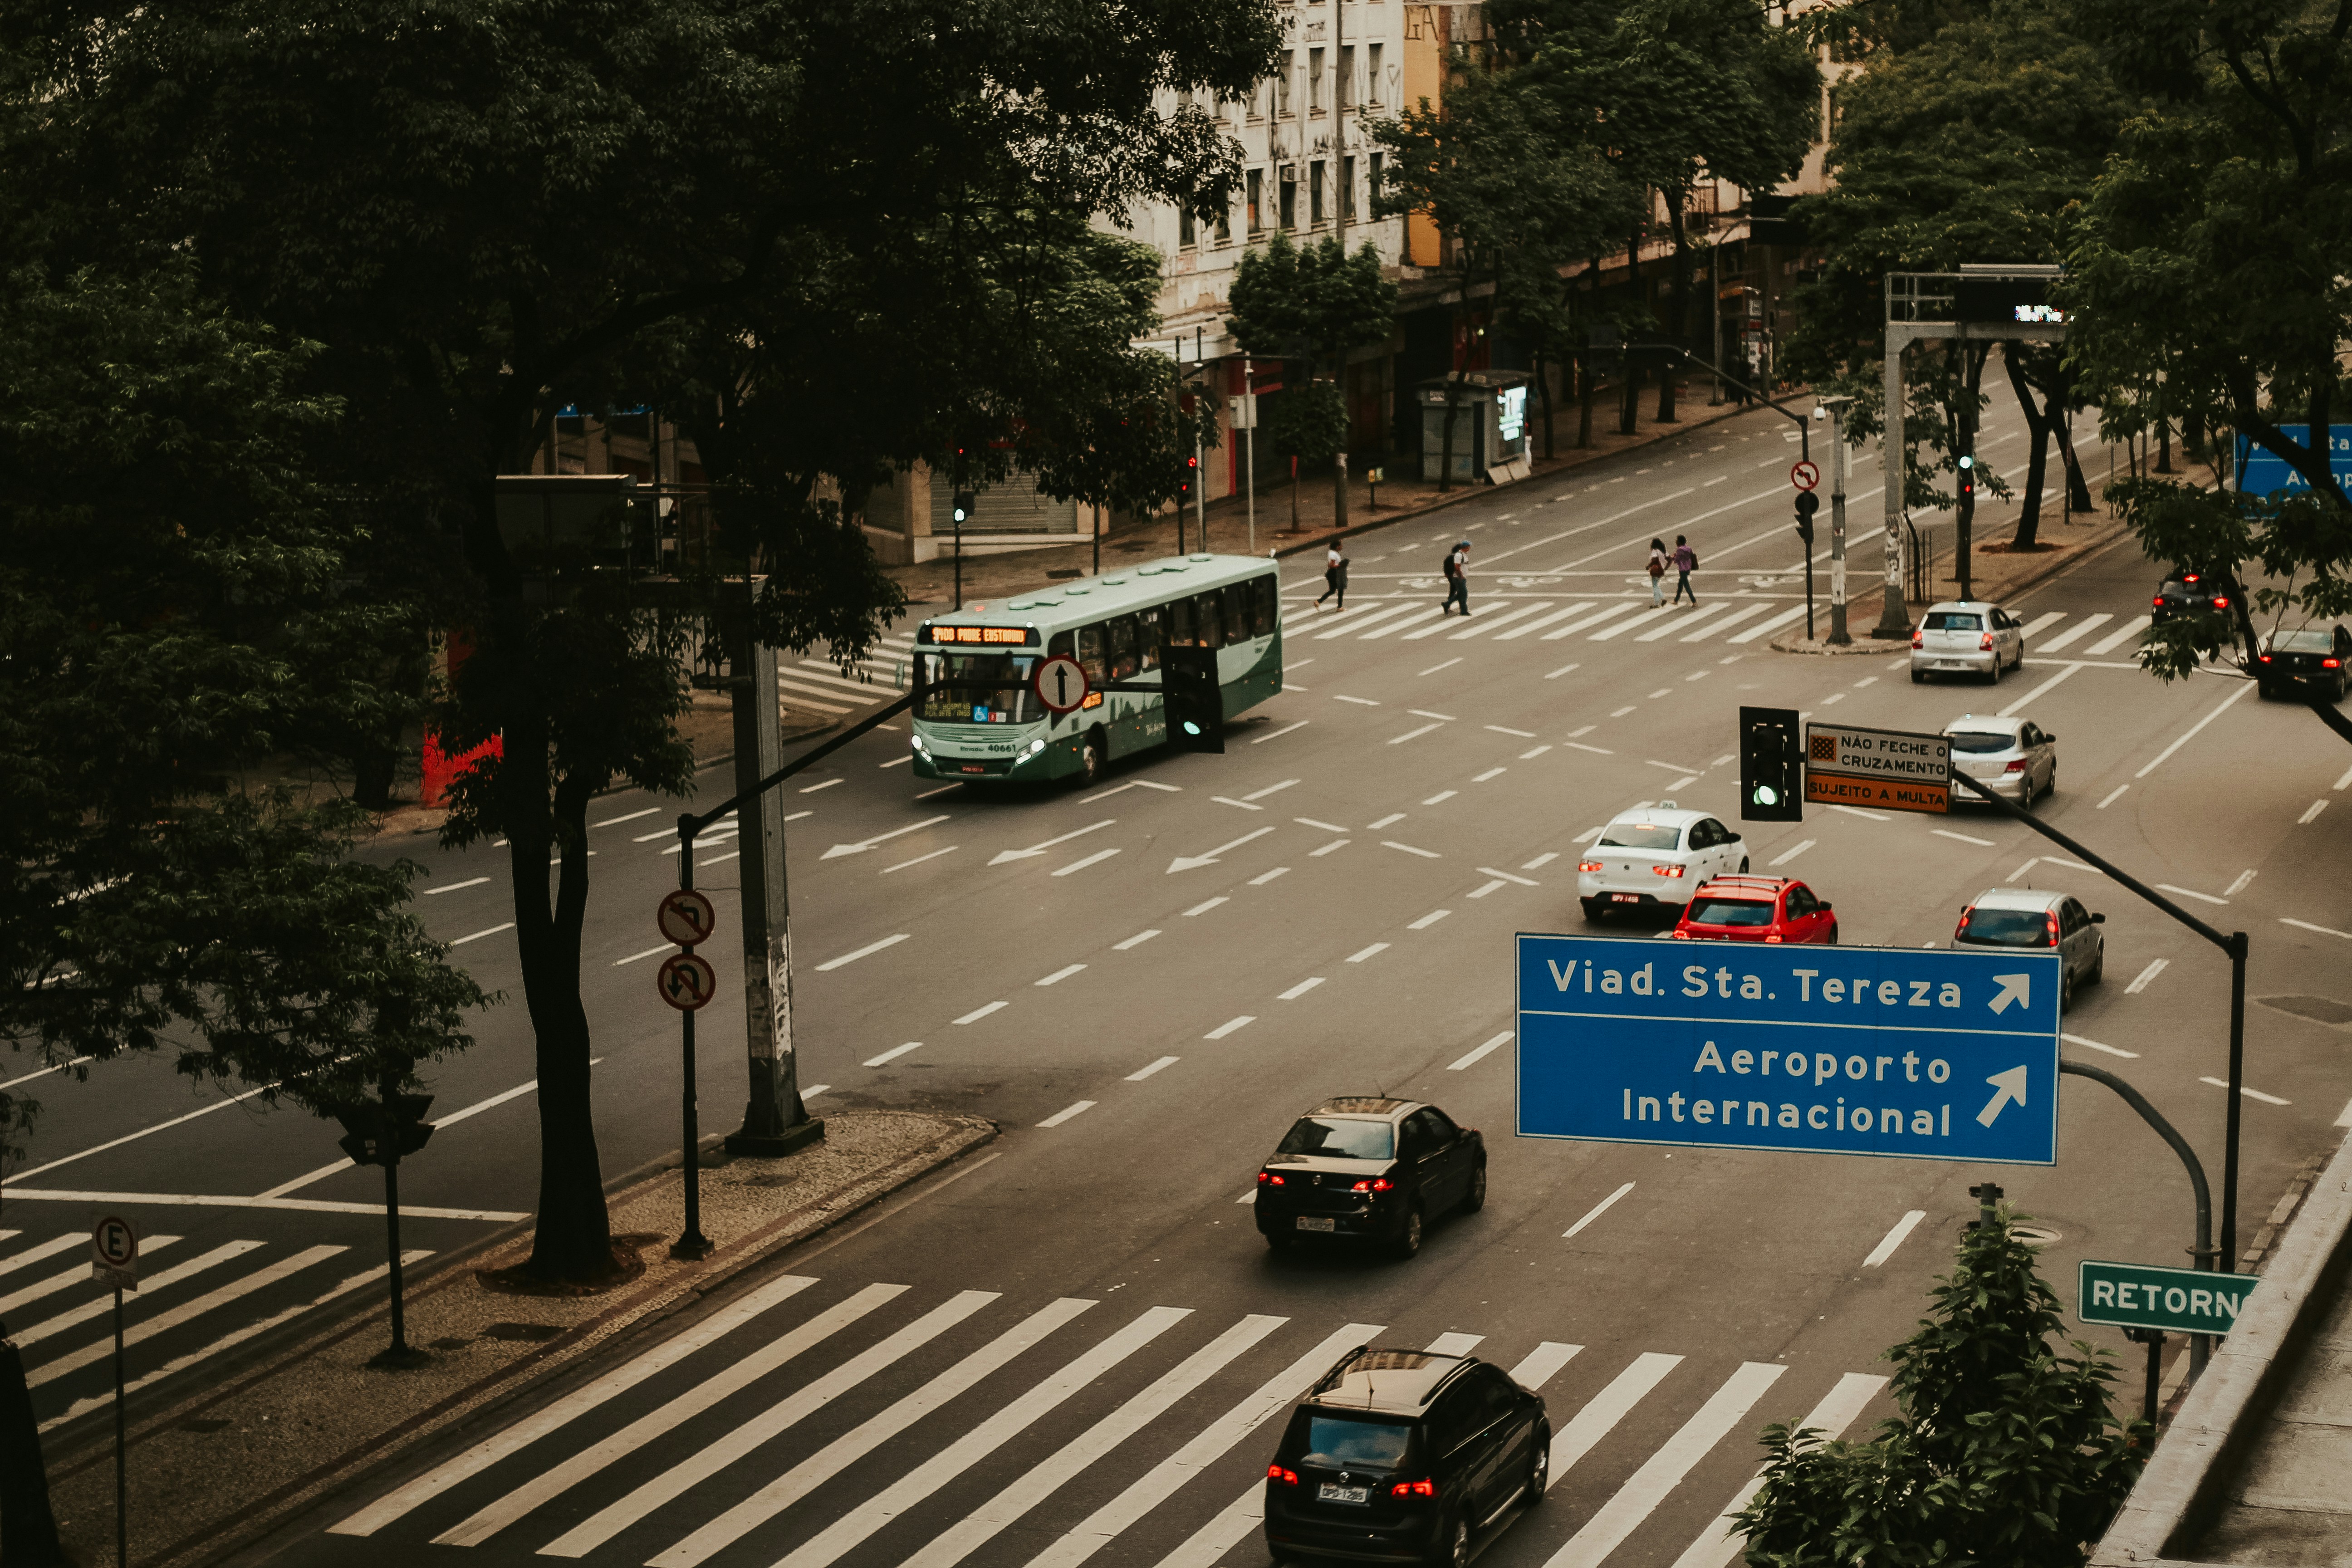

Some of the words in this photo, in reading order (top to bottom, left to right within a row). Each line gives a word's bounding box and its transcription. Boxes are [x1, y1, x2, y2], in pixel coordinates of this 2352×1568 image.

[1842, 735, 1872, 750] NÃO
[1880, 740, 1929, 756] FECHE
[1936, 746, 1946, 757] O
[1841, 755, 1946, 775] CRUZAMENTO
[1808, 782, 1872, 799] SUJEITO
[1879, 789, 1891, 800] A
[1896, 791, 1945, 806] MULTA
[1548, 960, 1665, 995] Viad.
[1682, 966, 1775, 1002] Sta.
[1793, 969, 1960, 1007] Tereza
[1693, 1041, 1950, 1086] Aeroporto
[1624, 1089, 1949, 1136] Internacional
[108, 1225, 123, 1257] E
[2093, 1280, 2248, 1319] RETORN
